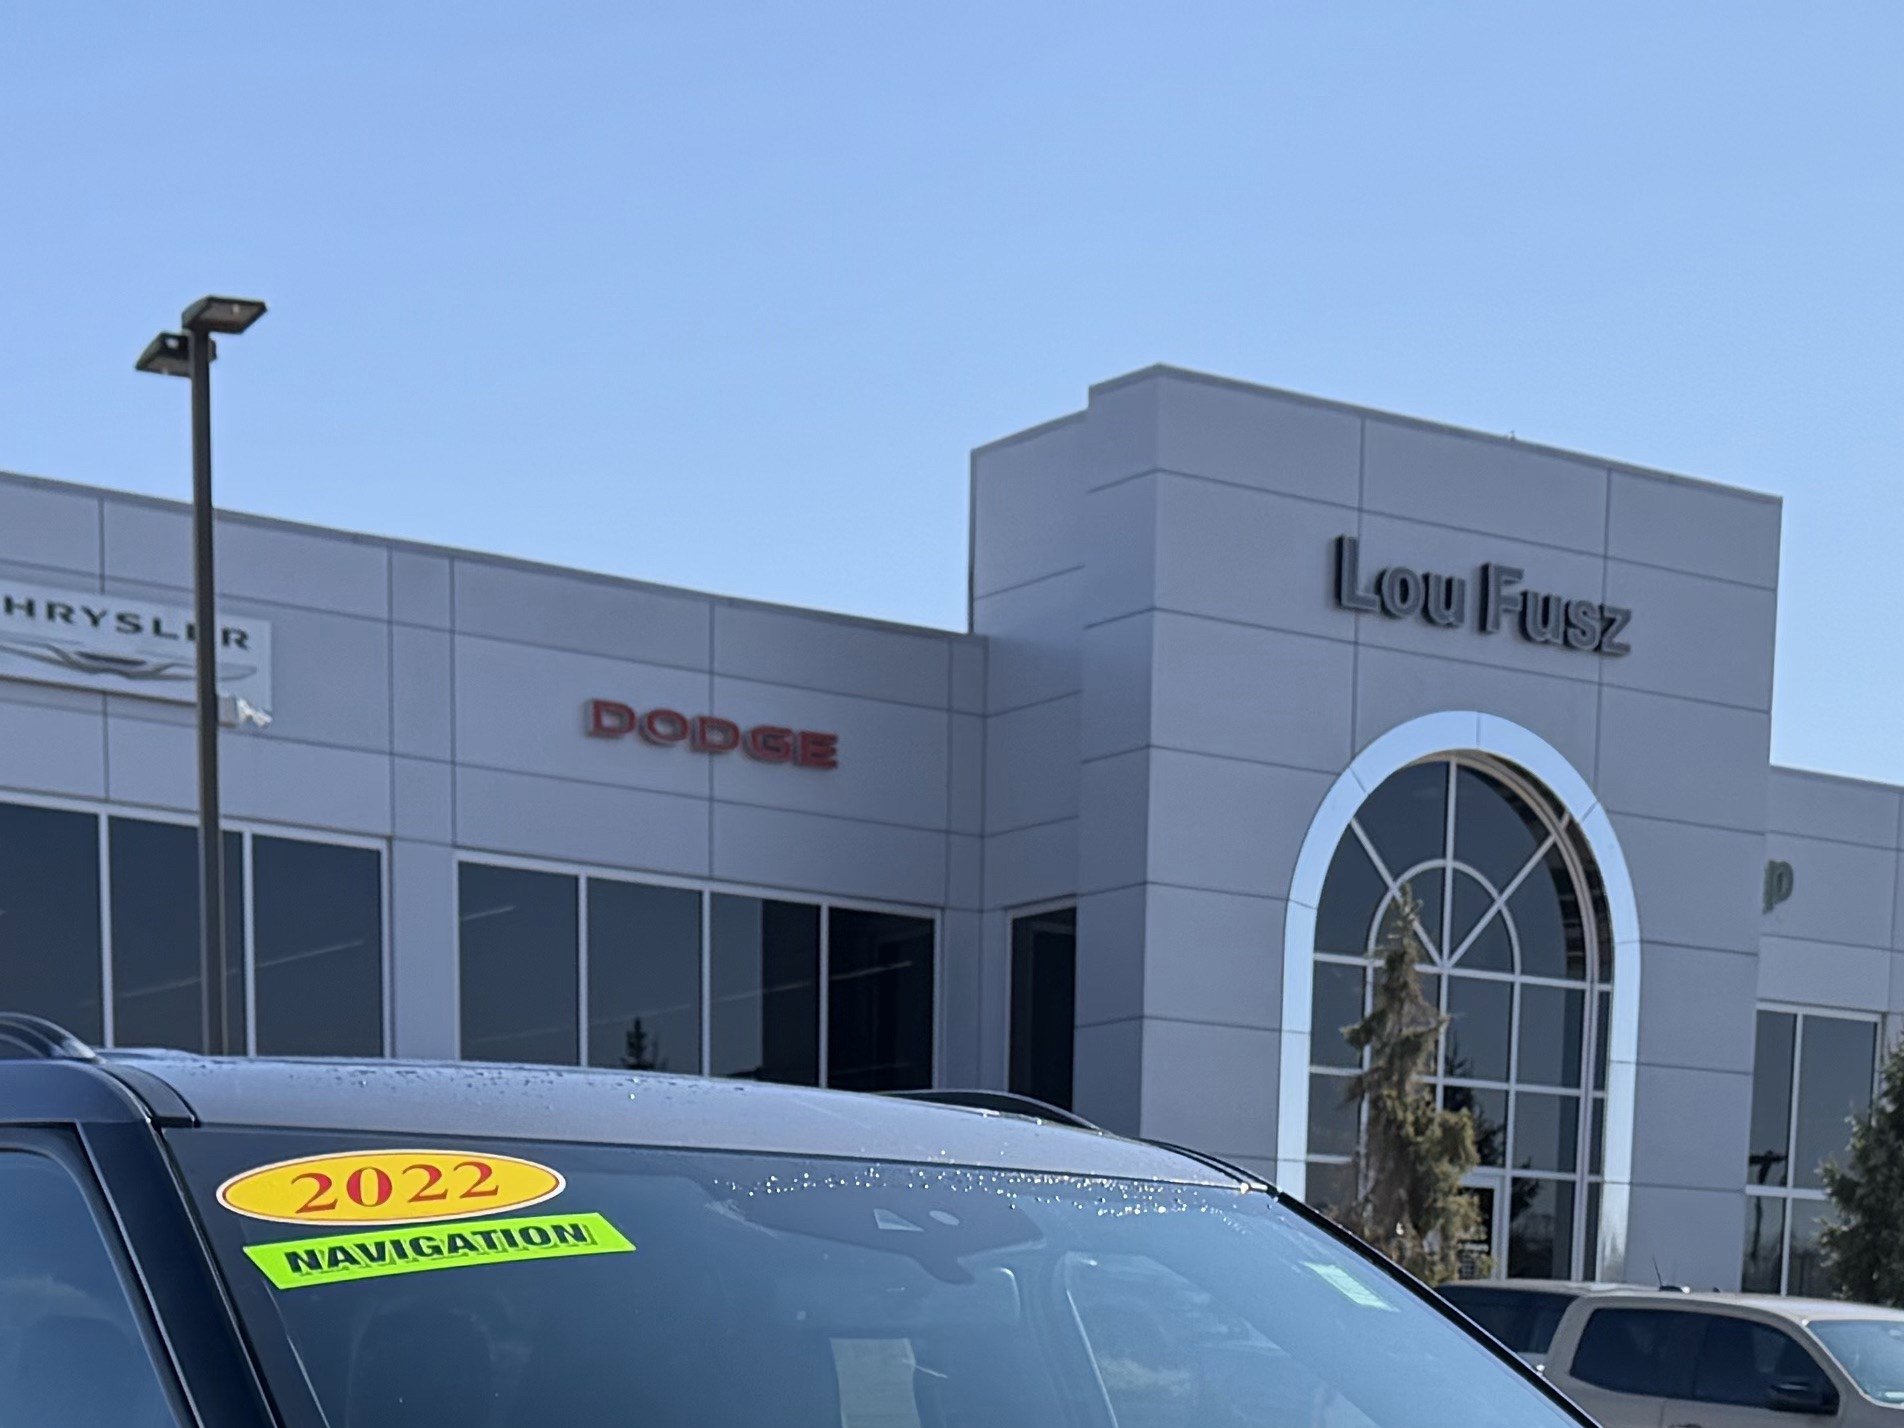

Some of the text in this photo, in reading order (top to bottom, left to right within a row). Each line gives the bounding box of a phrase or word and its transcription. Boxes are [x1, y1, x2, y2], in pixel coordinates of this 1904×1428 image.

[1336, 534, 1632, 656] Lou Fusz
[586, 698, 838, 770] DODGE
[290, 1161, 499, 1214] 2022
[284, 1223, 593, 1275] NAVIGATION
